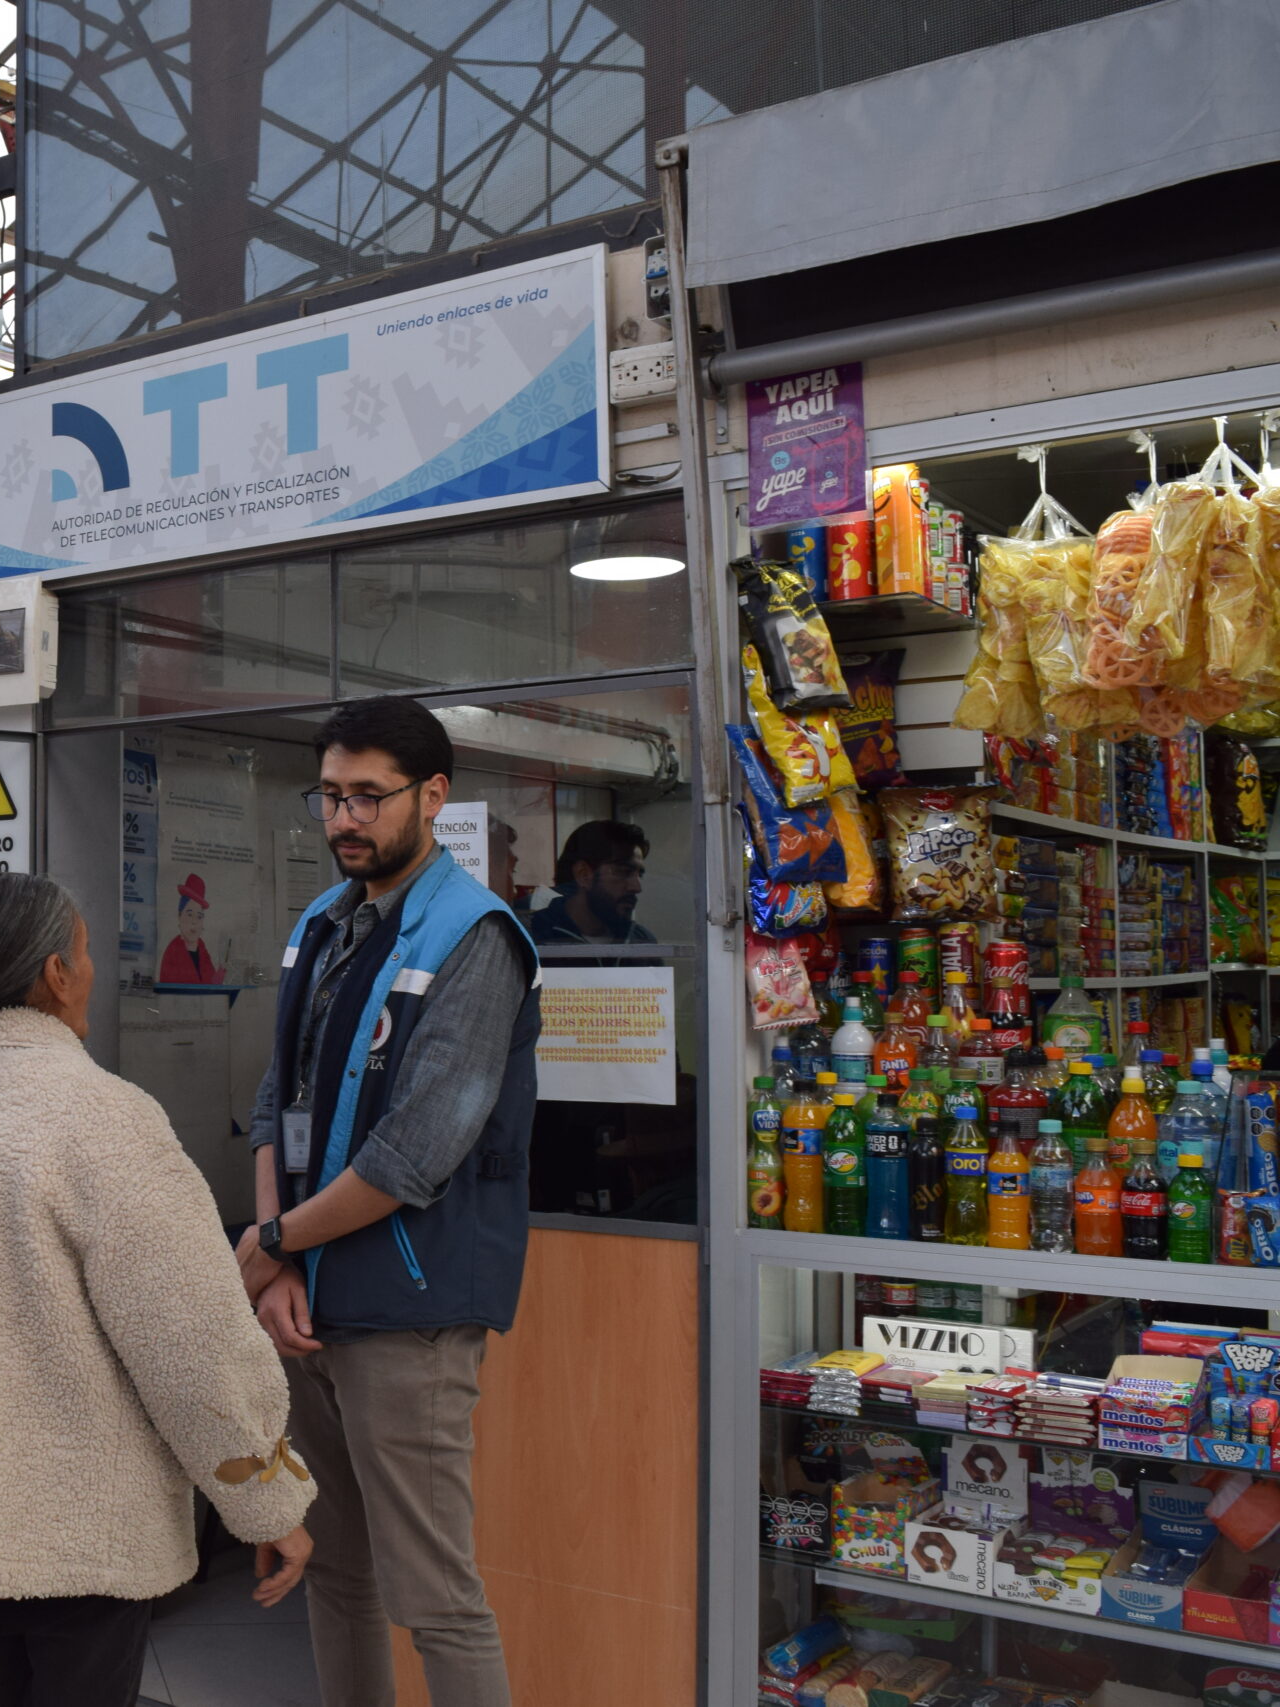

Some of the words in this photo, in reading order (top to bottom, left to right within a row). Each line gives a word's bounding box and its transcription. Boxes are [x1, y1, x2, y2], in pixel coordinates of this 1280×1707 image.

[377, 315, 433, 336] Uniendo
[437, 300, 491, 322] enlaces
[495, 296, 513, 309] de
[517, 288, 549, 304] vida
[765, 368, 839, 404] YAPEA
[776, 387, 834, 425] AQUÍ
[51, 509, 122, 532] AUTORIDAD
[125, 503, 143, 519] DE
[146, 488, 229, 515] REGULACIÓN
[234, 486, 242, 499] Y
[245, 465, 350, 496] FISCALIZACIÓN
[756, 467, 807, 511] yape
[60, 535, 77, 548] DE
[80, 507, 225, 545] TELECOMUNICACIONES
[229, 505, 237, 517] Y
[240, 486, 340, 515] TRANSPORTES
[579, 1018, 631, 1027] PADRES
[758, 1120, 780, 1129] VIDA
[1264, 1152, 1279, 1197] OREO
[1254, 1218, 1274, 1262] OREO
[878, 1323, 985, 1357] VIZZIO
[1224, 1343, 1275, 1363] PUSH
[1233, 1357, 1270, 1372] POP
[1102, 1409, 1165, 1428] mentos
[1103, 1438, 1164, 1453] mentos
[956, 1480, 1010, 1498] mecano
[772, 1524, 821, 1536] ROCKLETS
[976, 1542, 986, 1590] mecano
